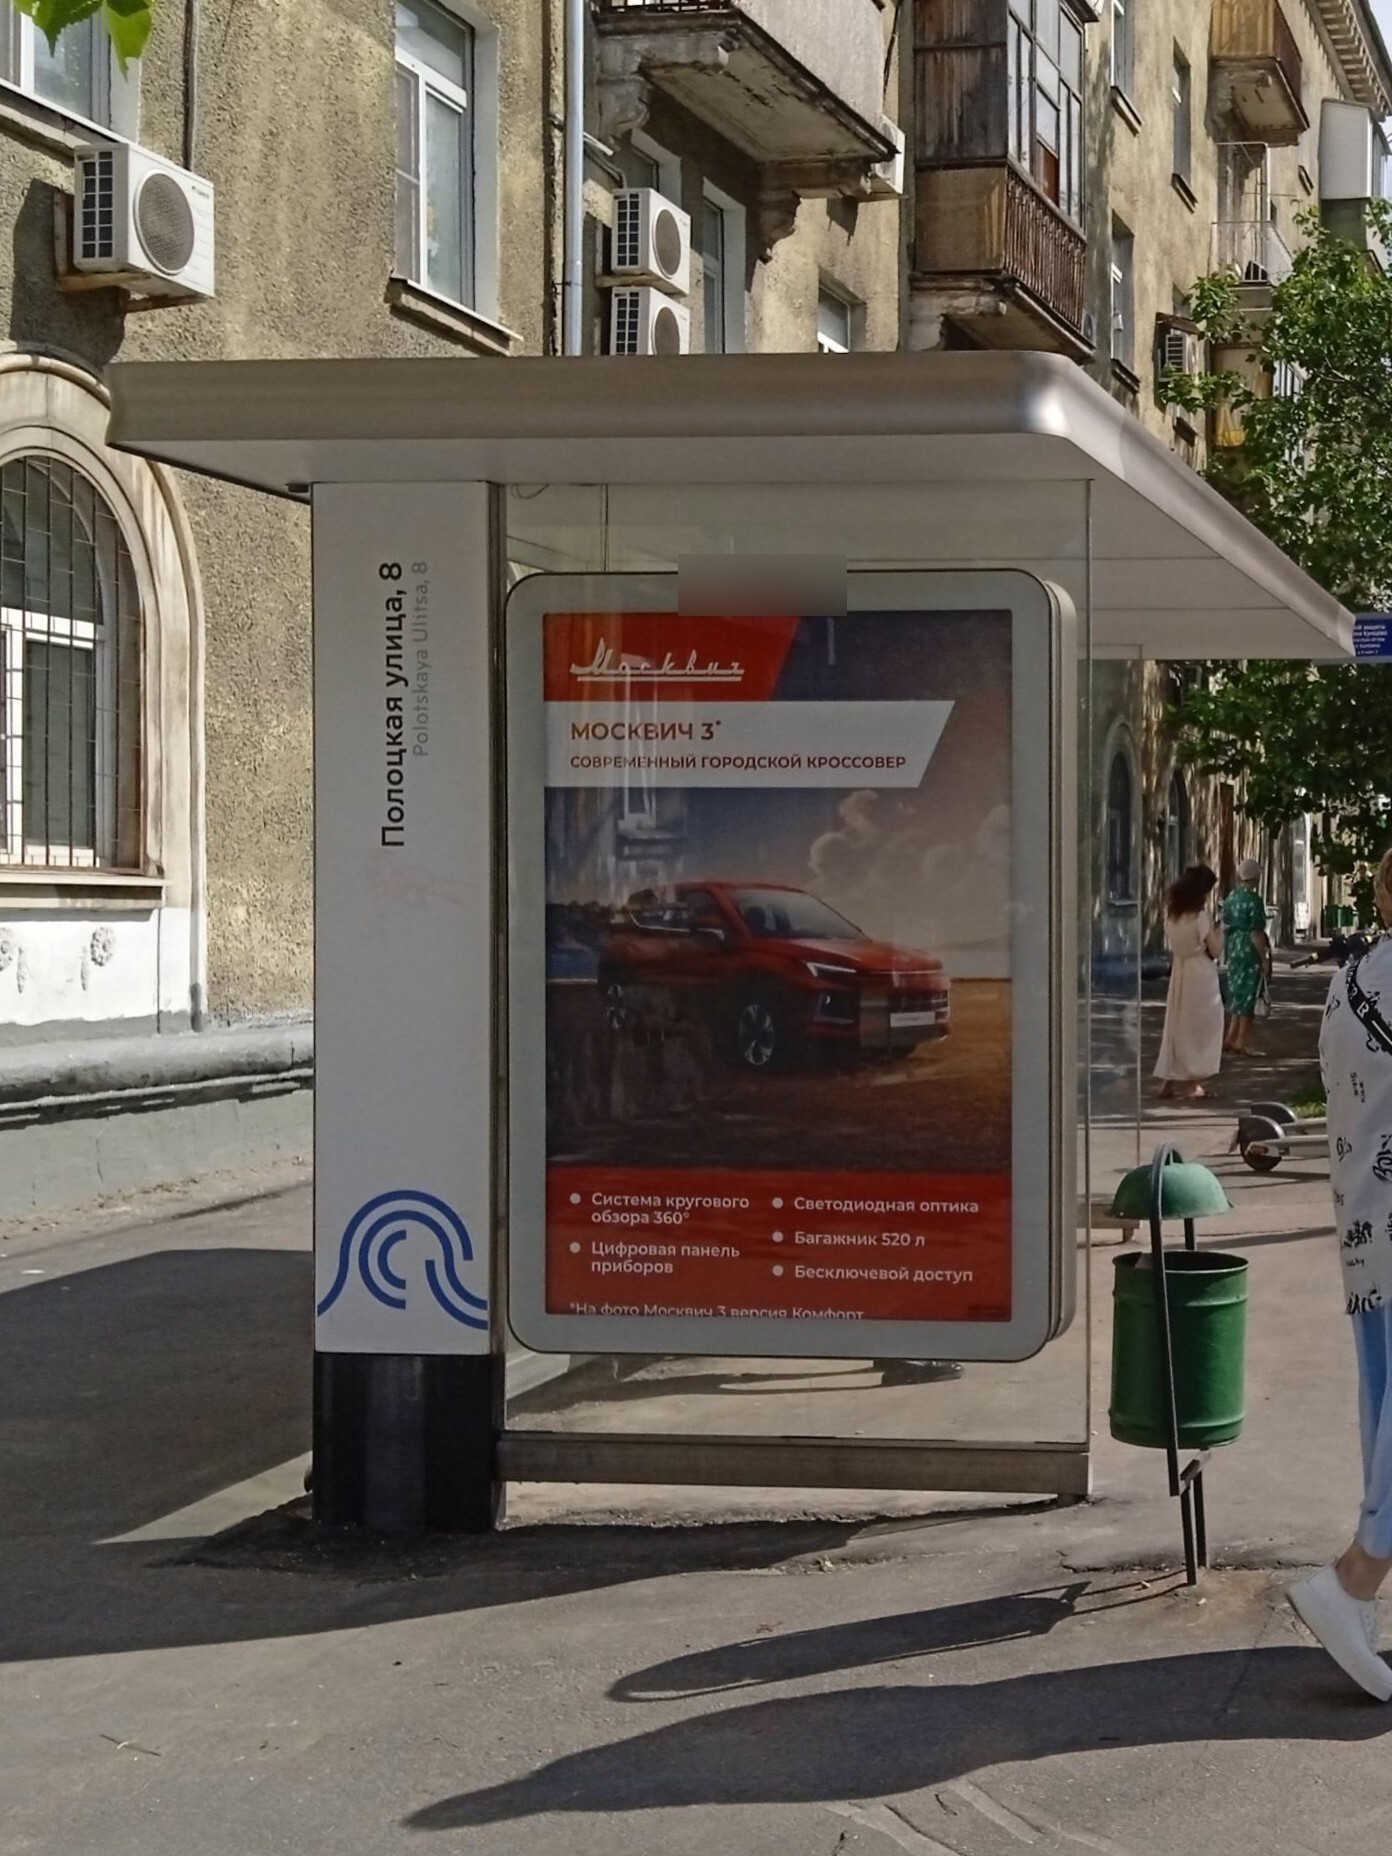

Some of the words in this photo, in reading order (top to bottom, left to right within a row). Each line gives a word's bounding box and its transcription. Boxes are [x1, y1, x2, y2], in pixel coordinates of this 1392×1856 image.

[379, 562, 402, 581] 8
[412, 562, 428, 574] 8
[412, 577, 431, 641] Ulitsa,
[384, 588, 408, 687] улица,
[570, 637, 745, 677] Москвич
[412, 650, 432, 756] Polotskaya
[571, 722, 693, 740] МОСКВИЧ
[570, 753, 696, 769] СОВРЕМЕННЫЙ
[702, 753, 802, 771] ГОРОДСКОЙ
[807, 755, 907, 769] КРОССОВЕР
[381, 698, 407, 847] Полоцкая
[591, 1192, 661, 1207] Система
[666, 1195, 750, 1210] кругового
[794, 1197, 915, 1213] Светодиодная
[920, 1202, 979, 1213] оптика
[591, 1210, 649, 1226] обзора
[653, 1211, 690, 1225] 360°
[795, 1231, 877, 1245] Багажник
[881, 1233, 911, 1246] 520
[914, 1235, 925, 1247] л
[591, 1241, 677, 1258] Цифровая
[681, 1245, 740, 1258] панель
[591, 1259, 674, 1276] приборов
[795, 1265, 909, 1281] Бесключевой
[913, 1270, 973, 1284] доступ
[601, 1302, 639, 1316] фото
[644, 1304, 713, 1317] Москвич
